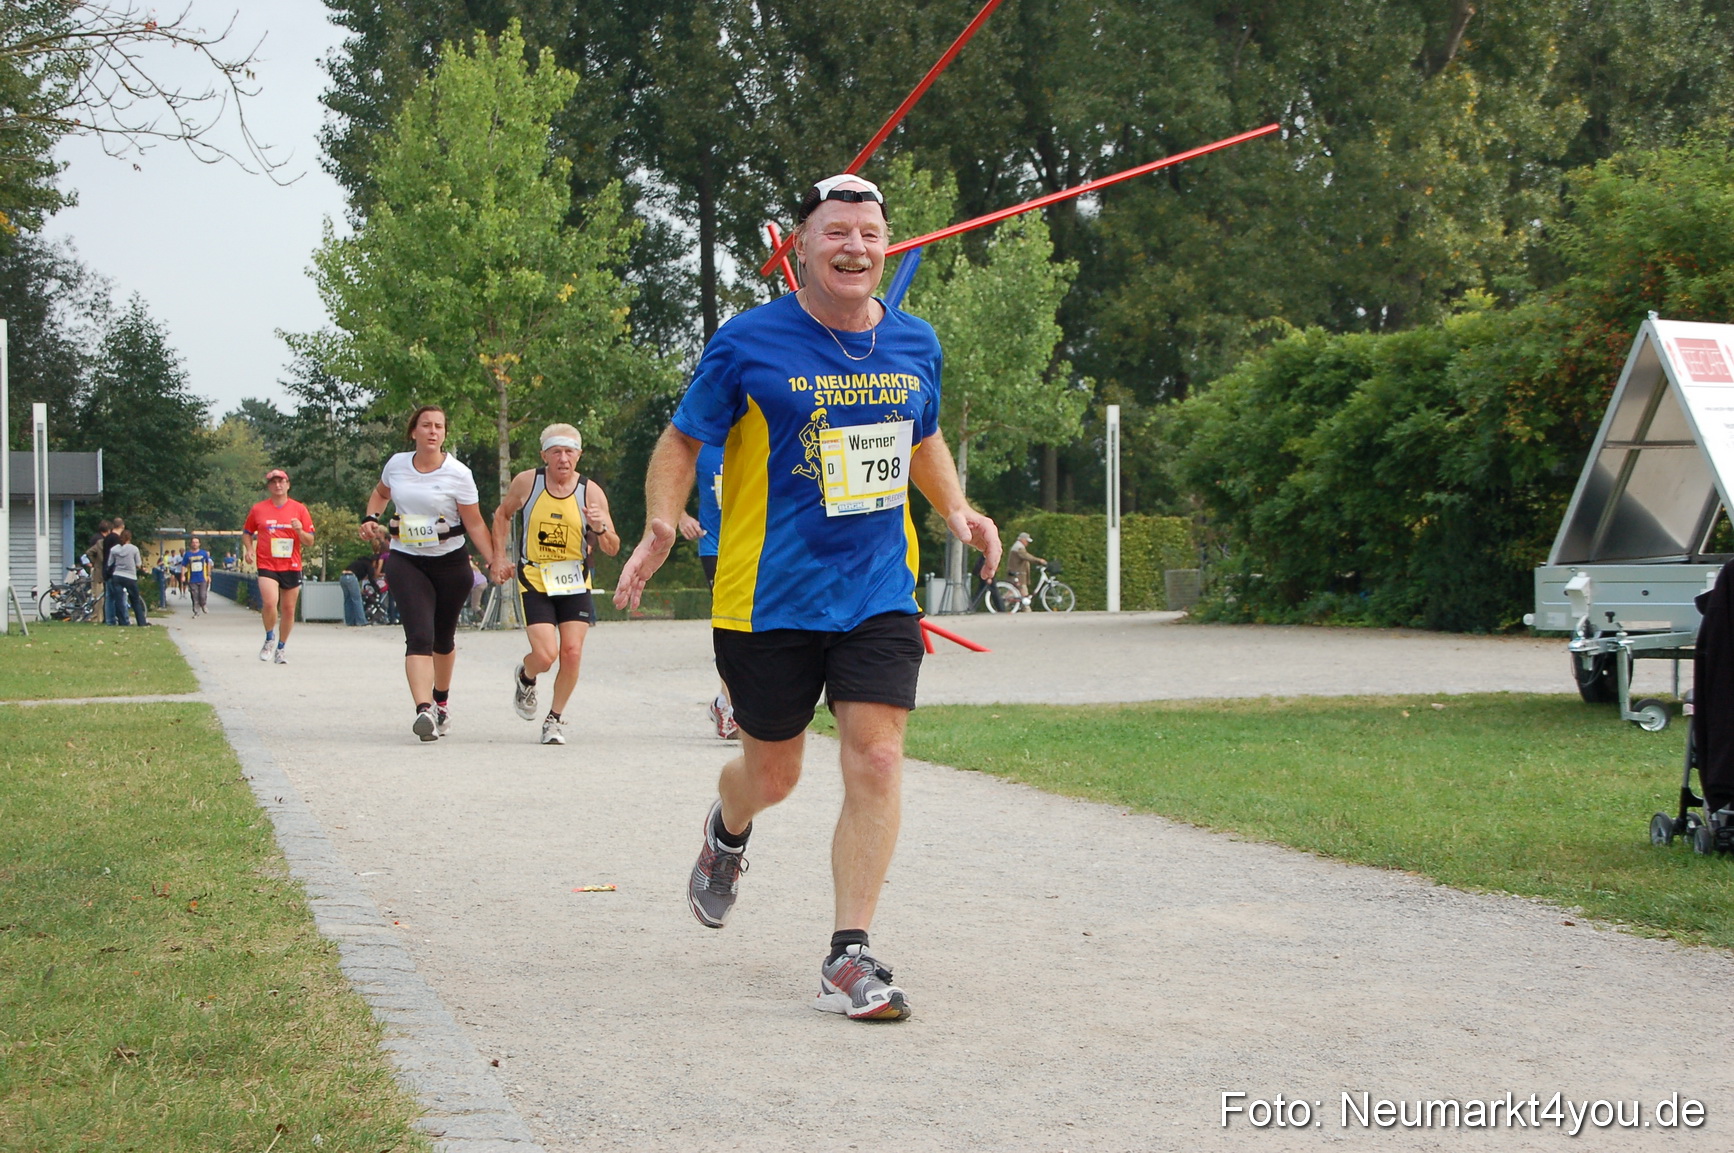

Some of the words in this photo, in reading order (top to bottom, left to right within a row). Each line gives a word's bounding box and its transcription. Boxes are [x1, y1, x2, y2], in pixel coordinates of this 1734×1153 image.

[788, 376, 813, 392] 10.
[815, 373, 921, 392] NEUMARKTER
[814, 389, 909, 406] STADTLAUF
[848, 434, 896, 451] Werner
[827, 462, 835, 475] D
[861, 456, 901, 483] 798
[408, 526, 434, 537] 1103
[555, 573, 580, 585] 1051
